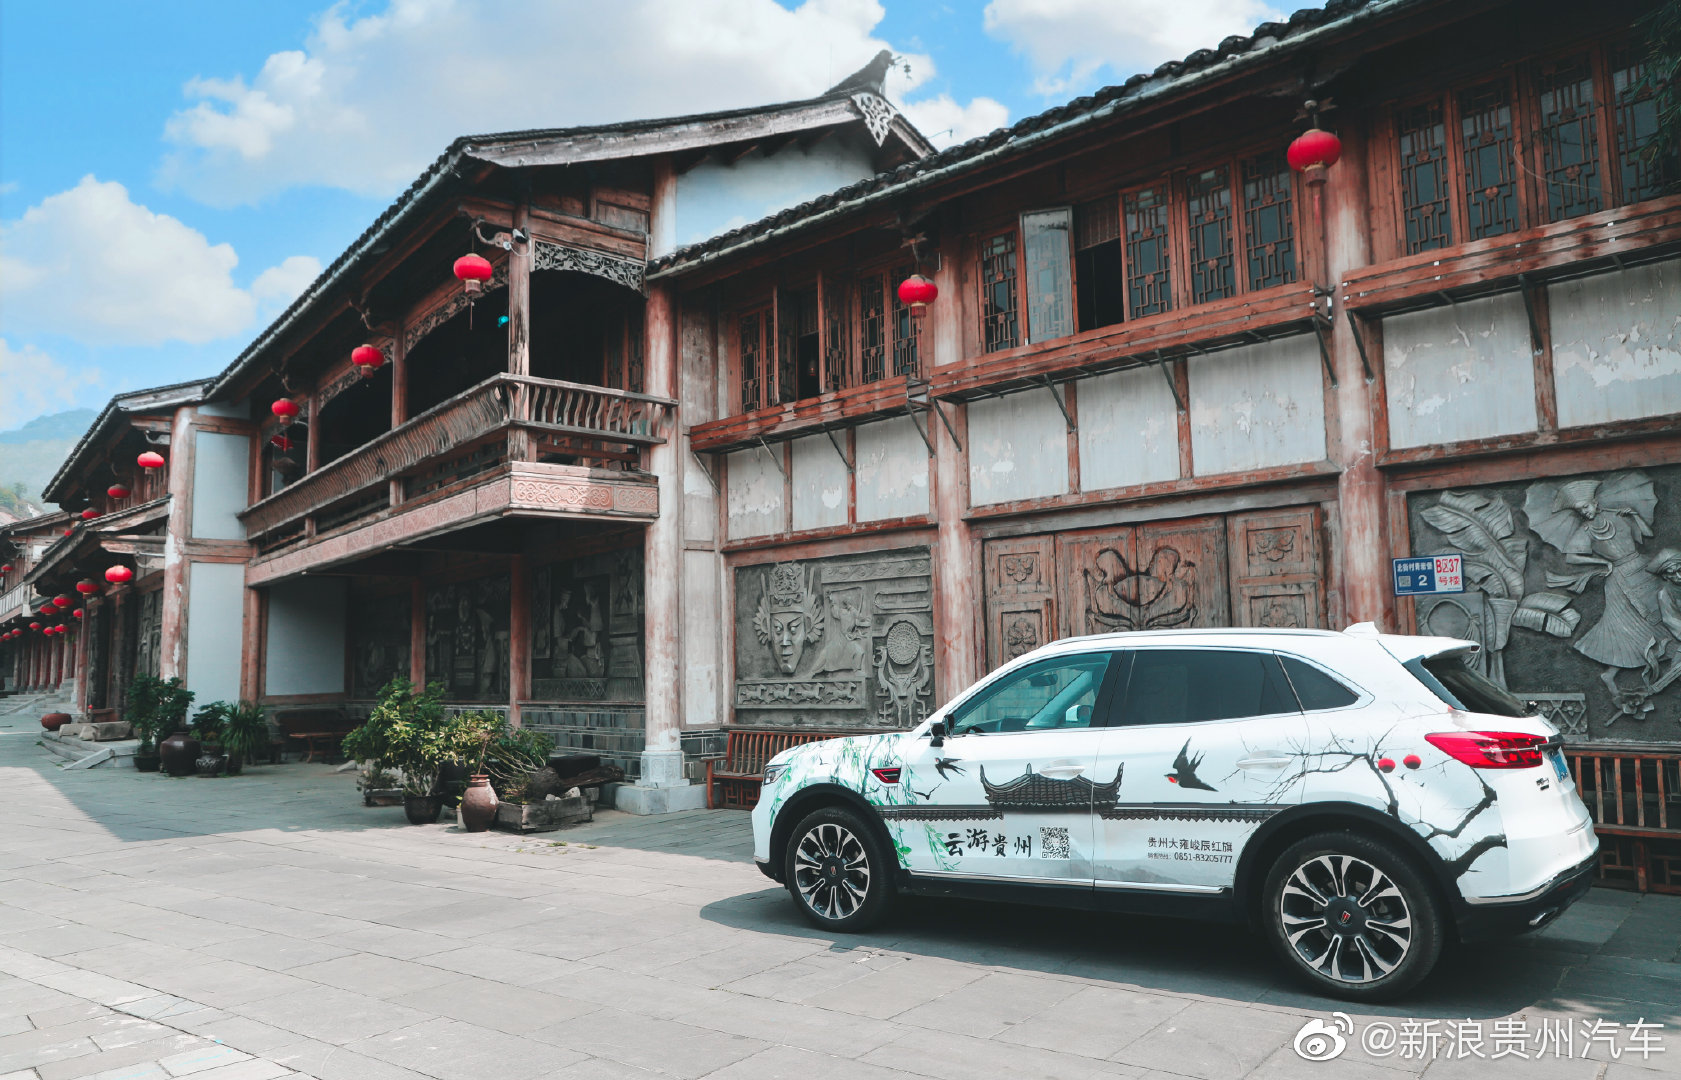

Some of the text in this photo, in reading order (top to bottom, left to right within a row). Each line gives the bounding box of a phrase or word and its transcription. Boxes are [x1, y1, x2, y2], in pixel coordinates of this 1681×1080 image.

[1436, 558, 1459, 573] B区37
[1418, 575, 1428, 586] 2
[1439, 576, 1460, 586] 号楼
